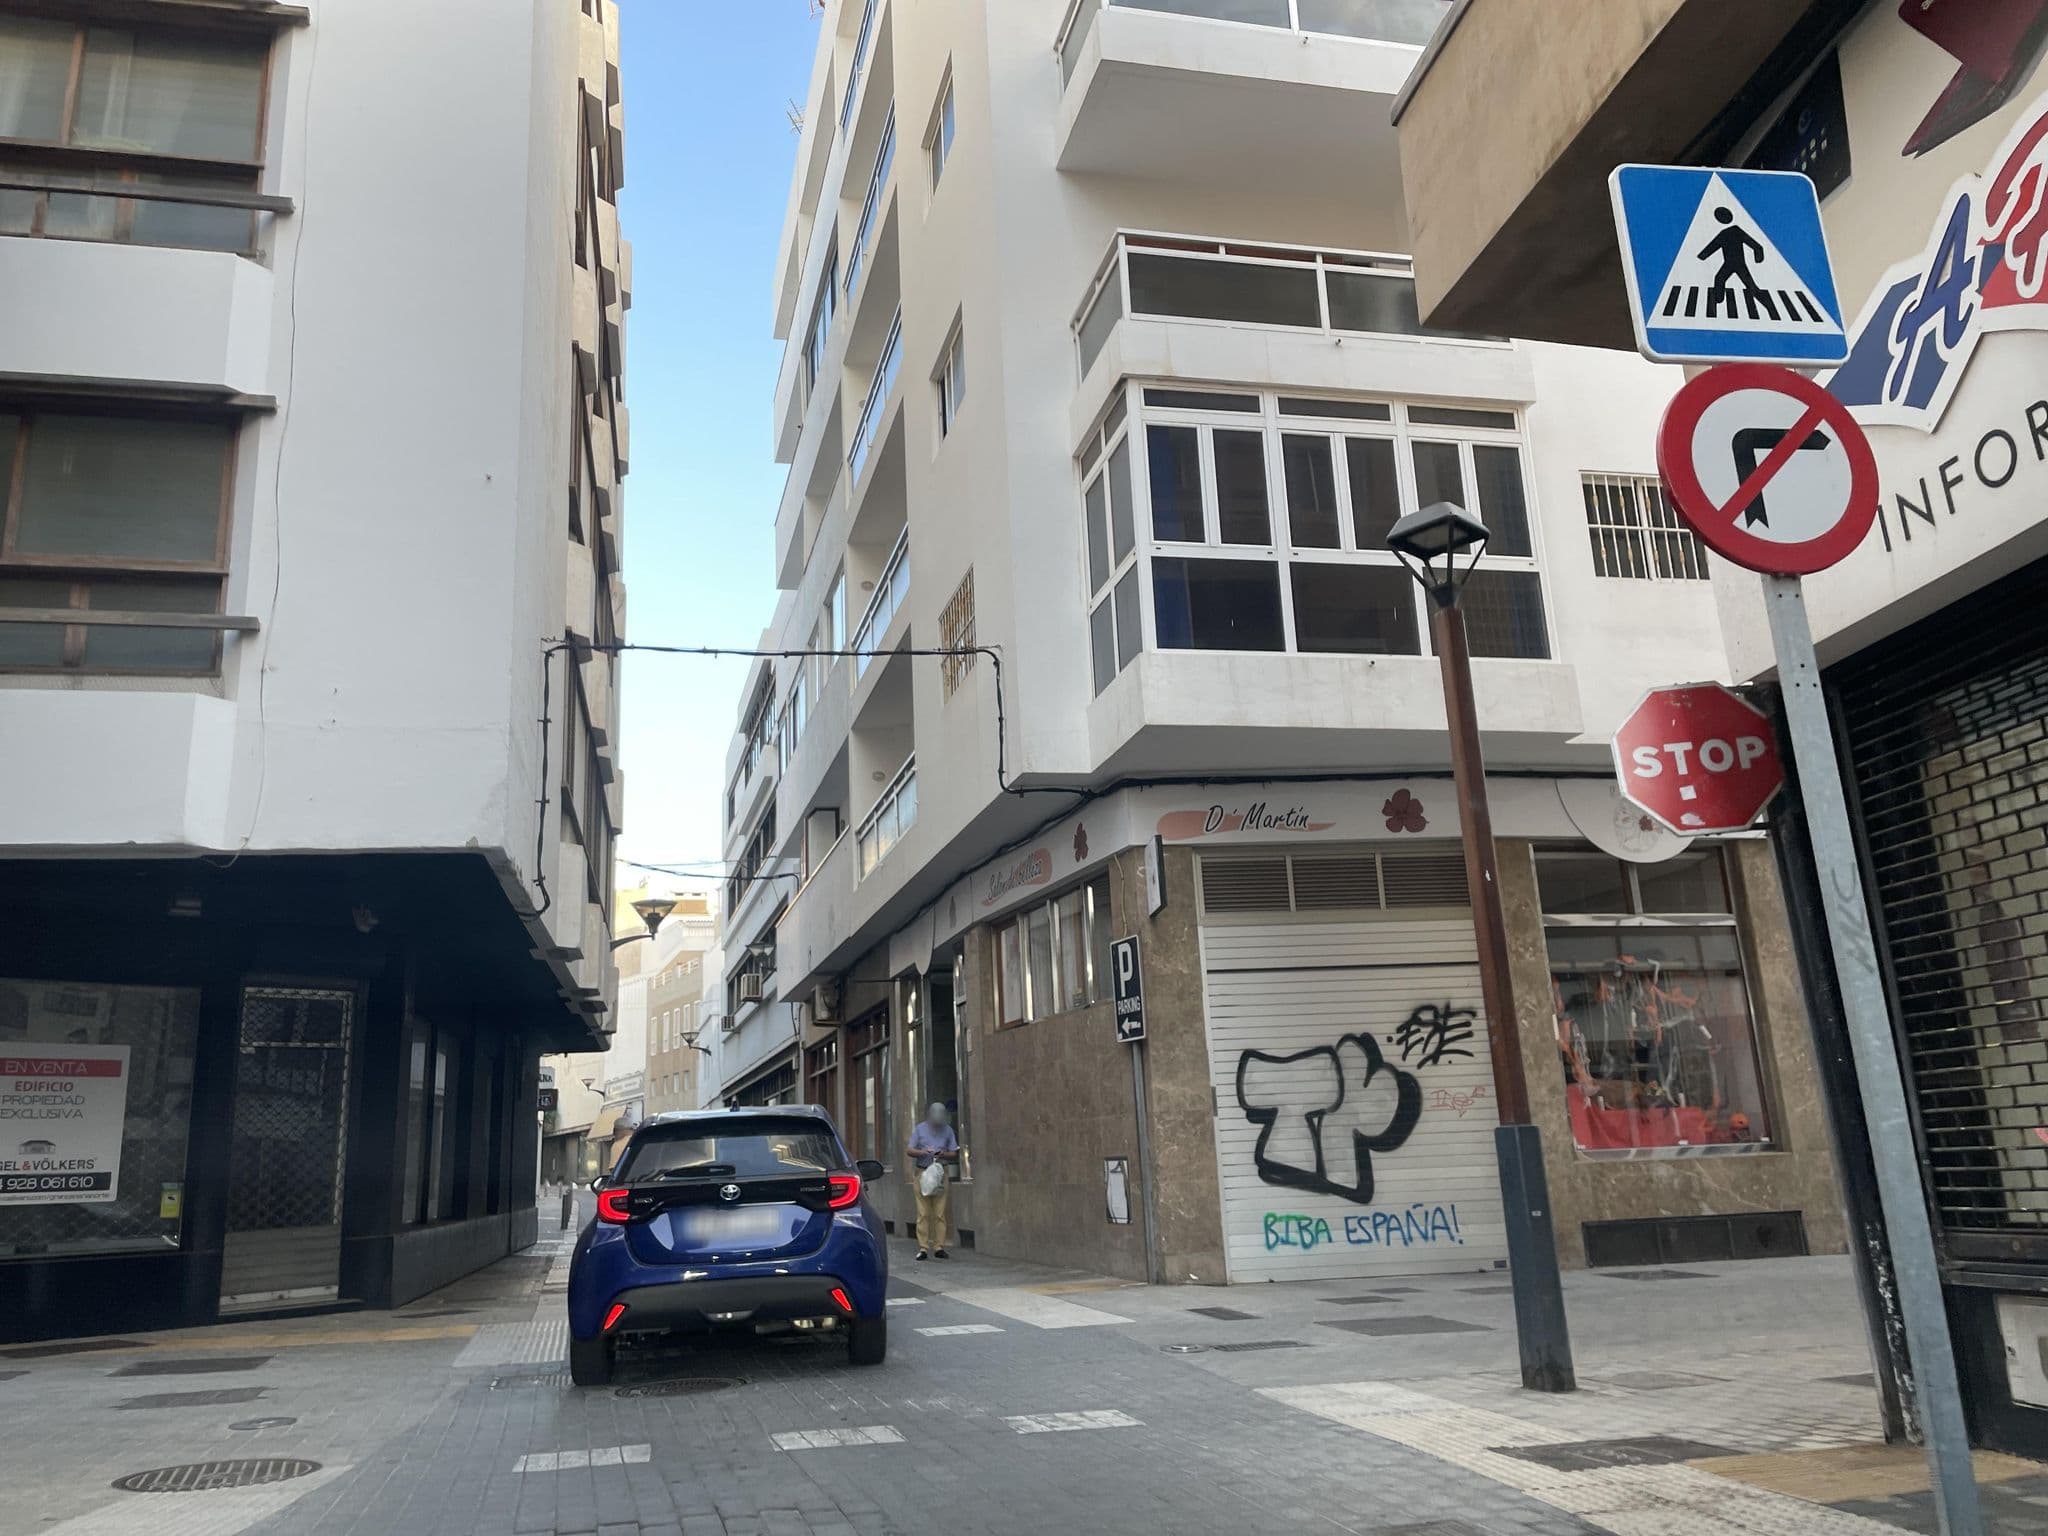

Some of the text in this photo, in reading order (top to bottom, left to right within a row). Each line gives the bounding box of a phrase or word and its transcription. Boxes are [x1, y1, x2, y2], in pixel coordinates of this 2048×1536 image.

[1632, 735, 1766, 779] STOP
[1117, 942, 1134, 998] P
[1117, 995, 1141, 1016] PARKING
[5, 1060, 89, 1074] EN VENTA
[15, 1080, 74, 1093] EDIFICIO
[1, 1094, 85, 1106] PROPIEDAD
[0, 1108, 84, 1120] EXCLUSIVA
[7, 1177, 37, 1190] 928
[40, 1176, 65, 1189] 061
[68, 1175, 94, 1188] 610
[1263, 1203, 1464, 1250] BIBA ESPAÑA!
